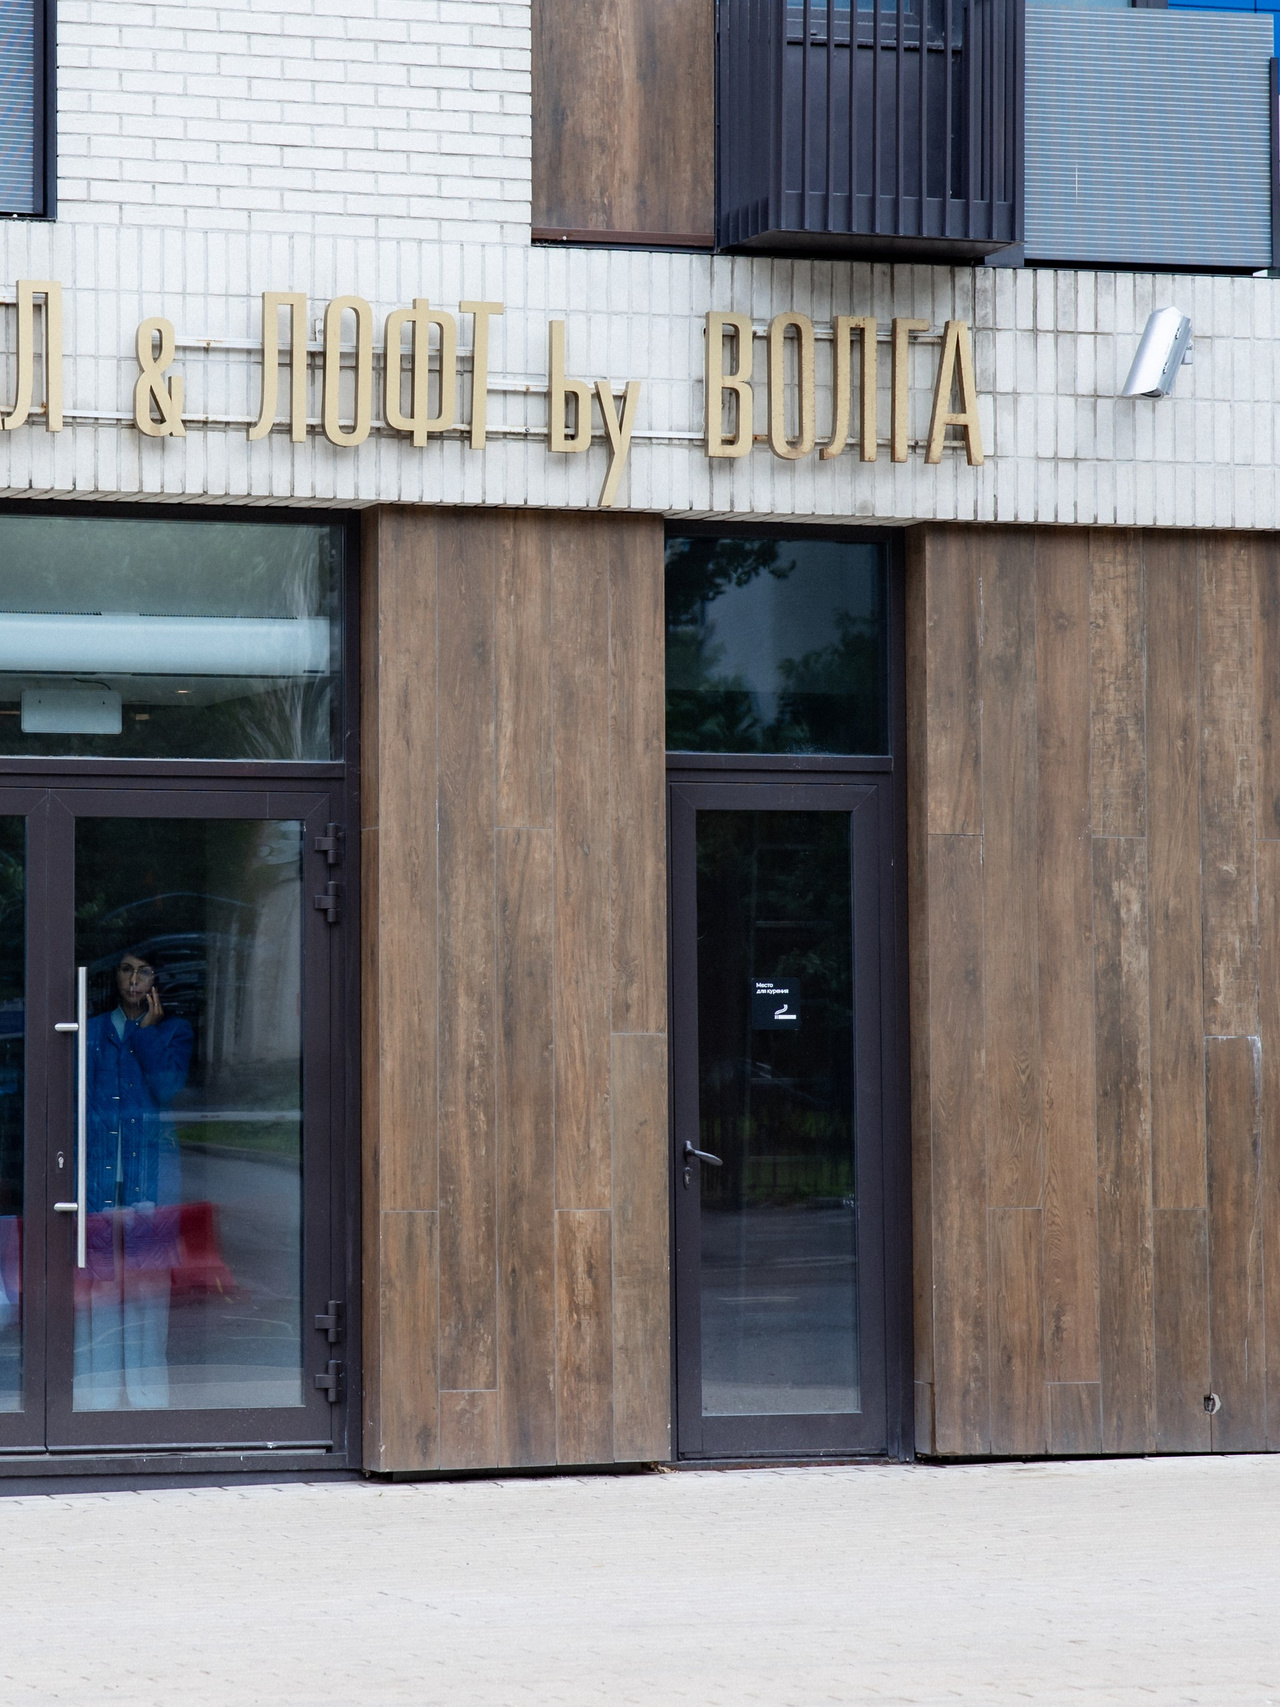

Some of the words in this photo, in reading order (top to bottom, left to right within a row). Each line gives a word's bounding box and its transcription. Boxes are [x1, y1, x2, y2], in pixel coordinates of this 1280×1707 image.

[134, 316, 187, 437] &
[248, 290, 504, 450] ЛОФТ
[548, 319, 642, 507] by
[705, 310, 984, 466] ВОЛГА
